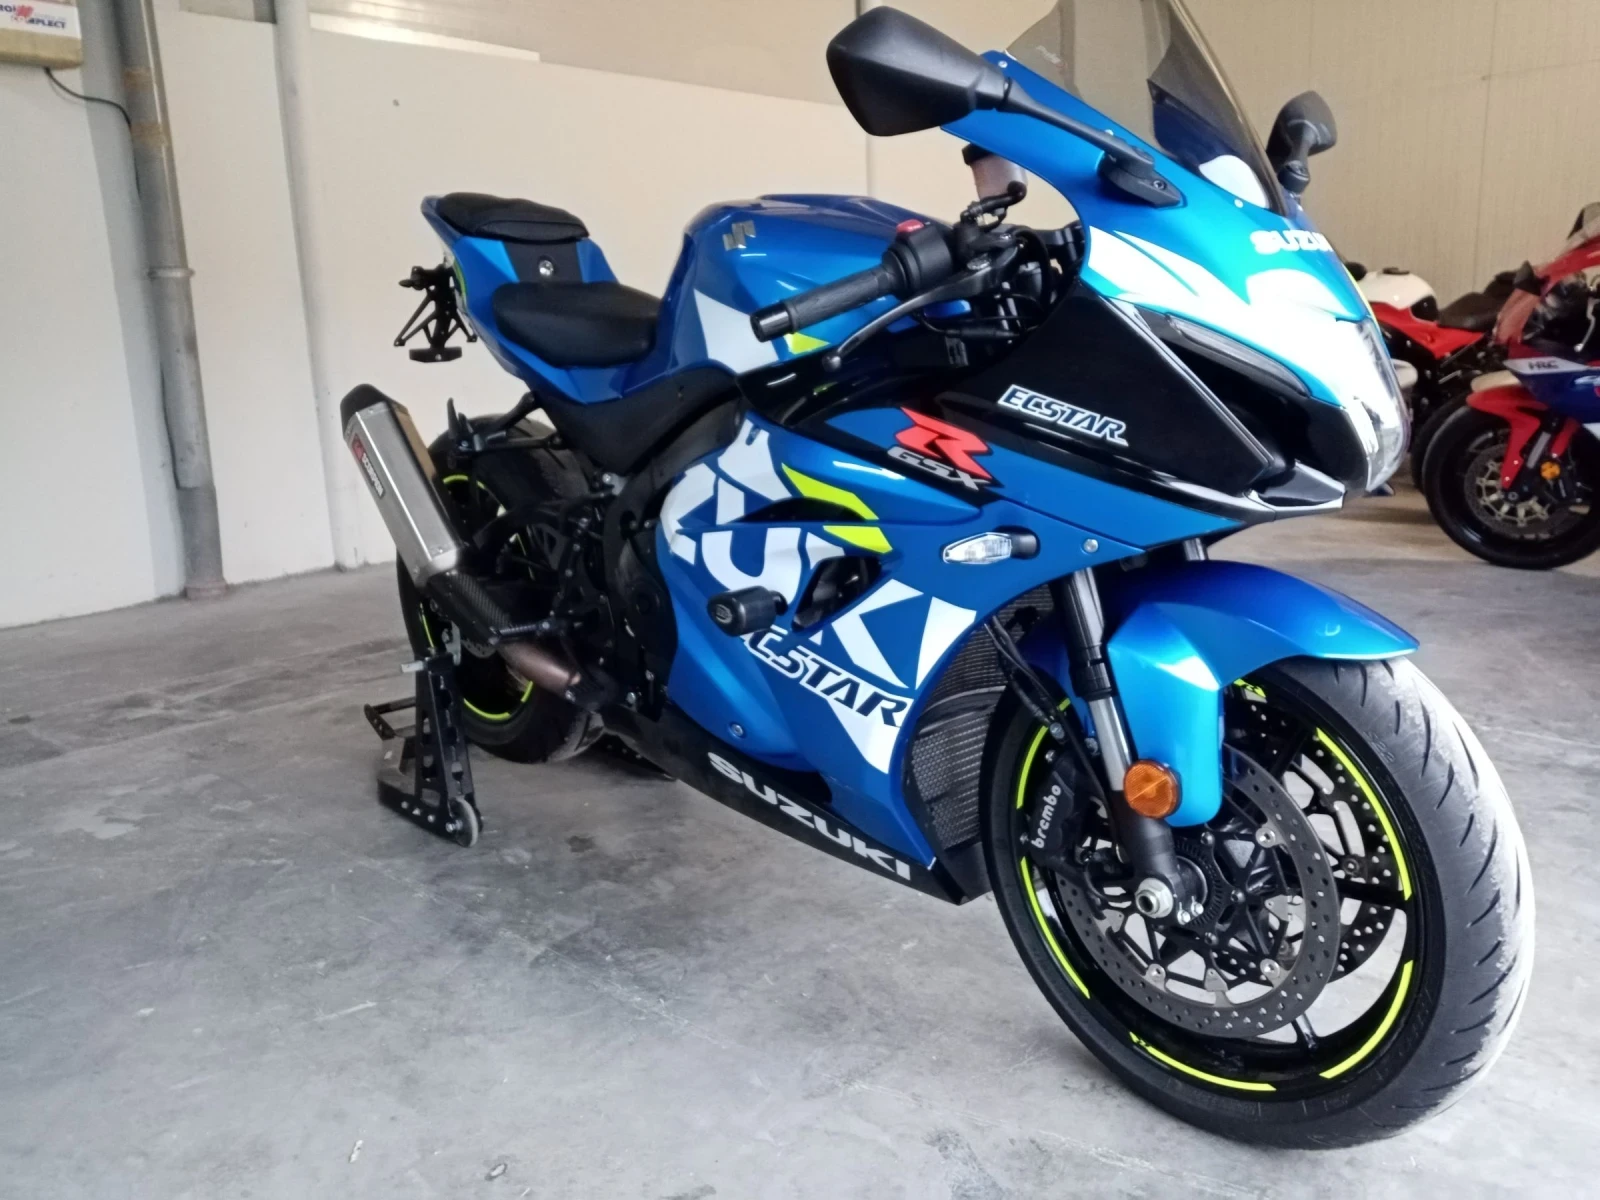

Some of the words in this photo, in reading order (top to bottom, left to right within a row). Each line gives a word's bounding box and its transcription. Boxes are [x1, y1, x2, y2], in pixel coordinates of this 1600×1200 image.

[998, 384, 1128, 447] ECSTAR
[887, 446, 991, 491] GSX
[742, 624, 914, 728] CSTAR
[708, 752, 911, 881] SUZUKI
[1030, 784, 1062, 849] brembo
